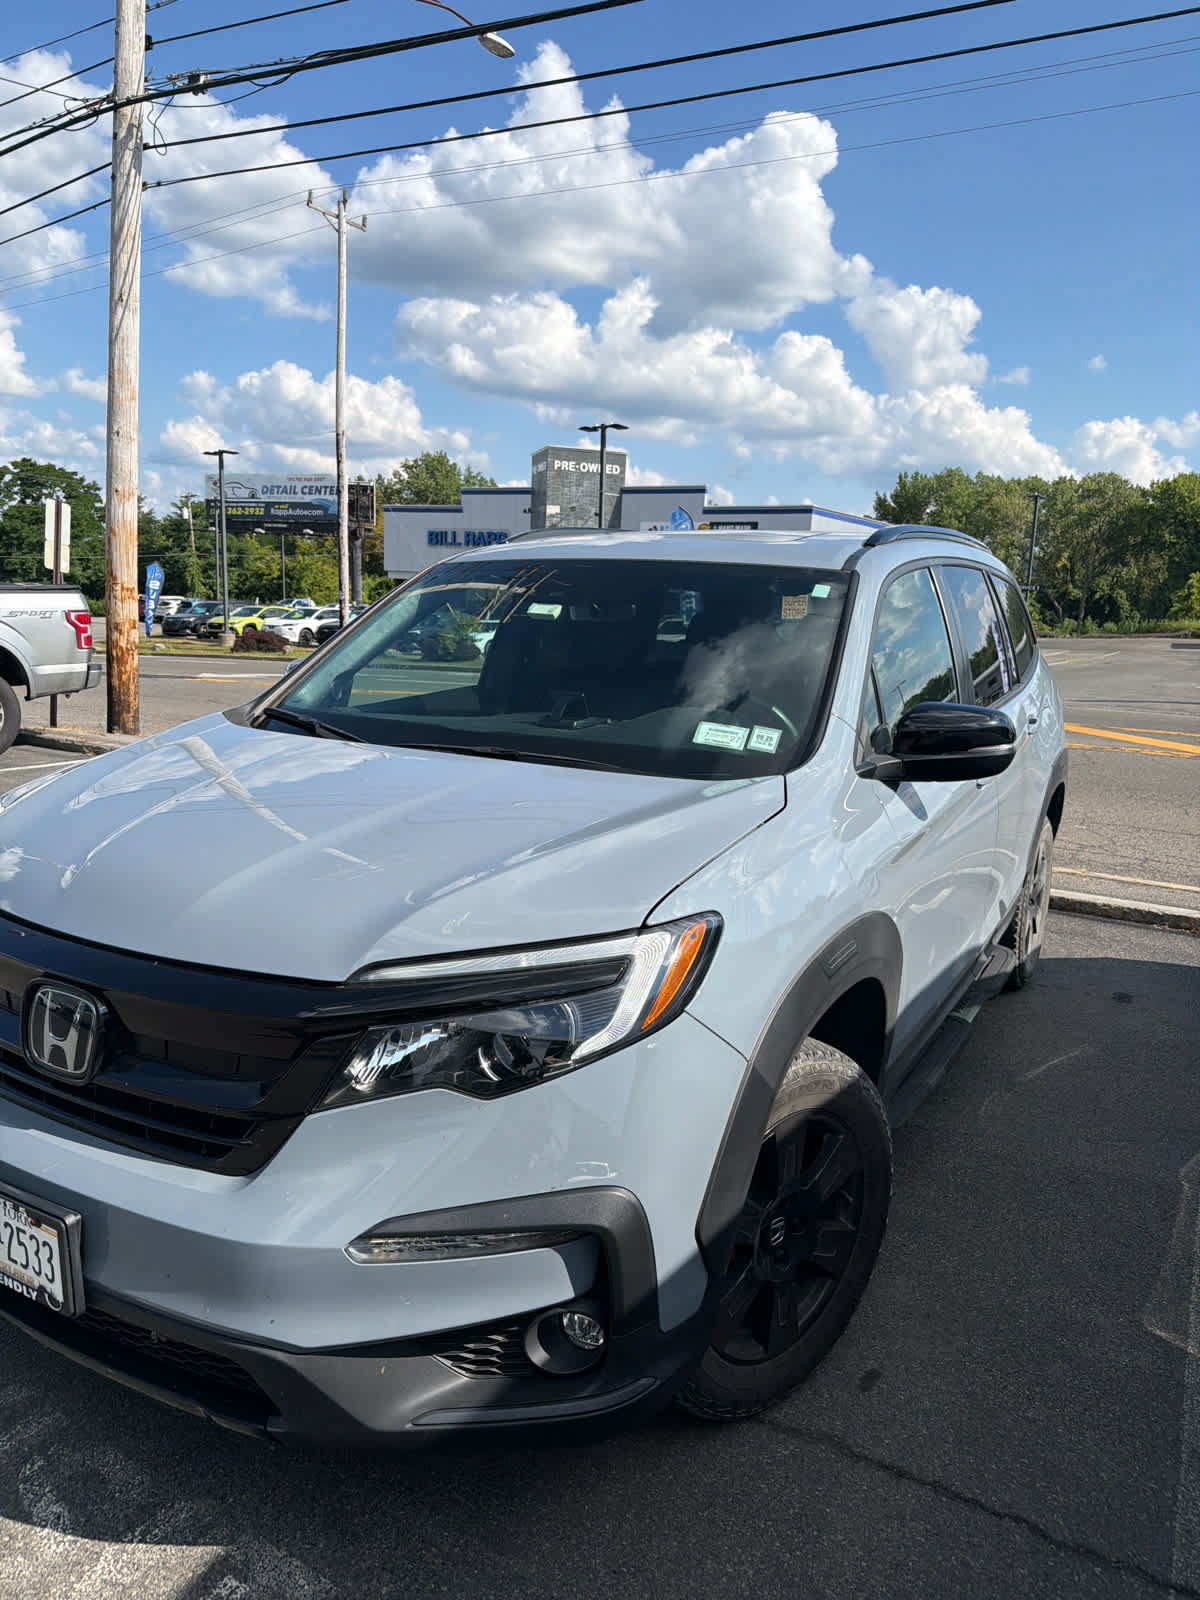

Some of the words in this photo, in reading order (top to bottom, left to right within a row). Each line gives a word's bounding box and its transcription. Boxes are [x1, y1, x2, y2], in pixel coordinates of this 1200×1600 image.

[261, 484, 298, 496] DETAIL
[301, 484, 339, 496] CENTE
[427, 530, 462, 546] BILL
[3, 1221, 55, 1284] 2533
